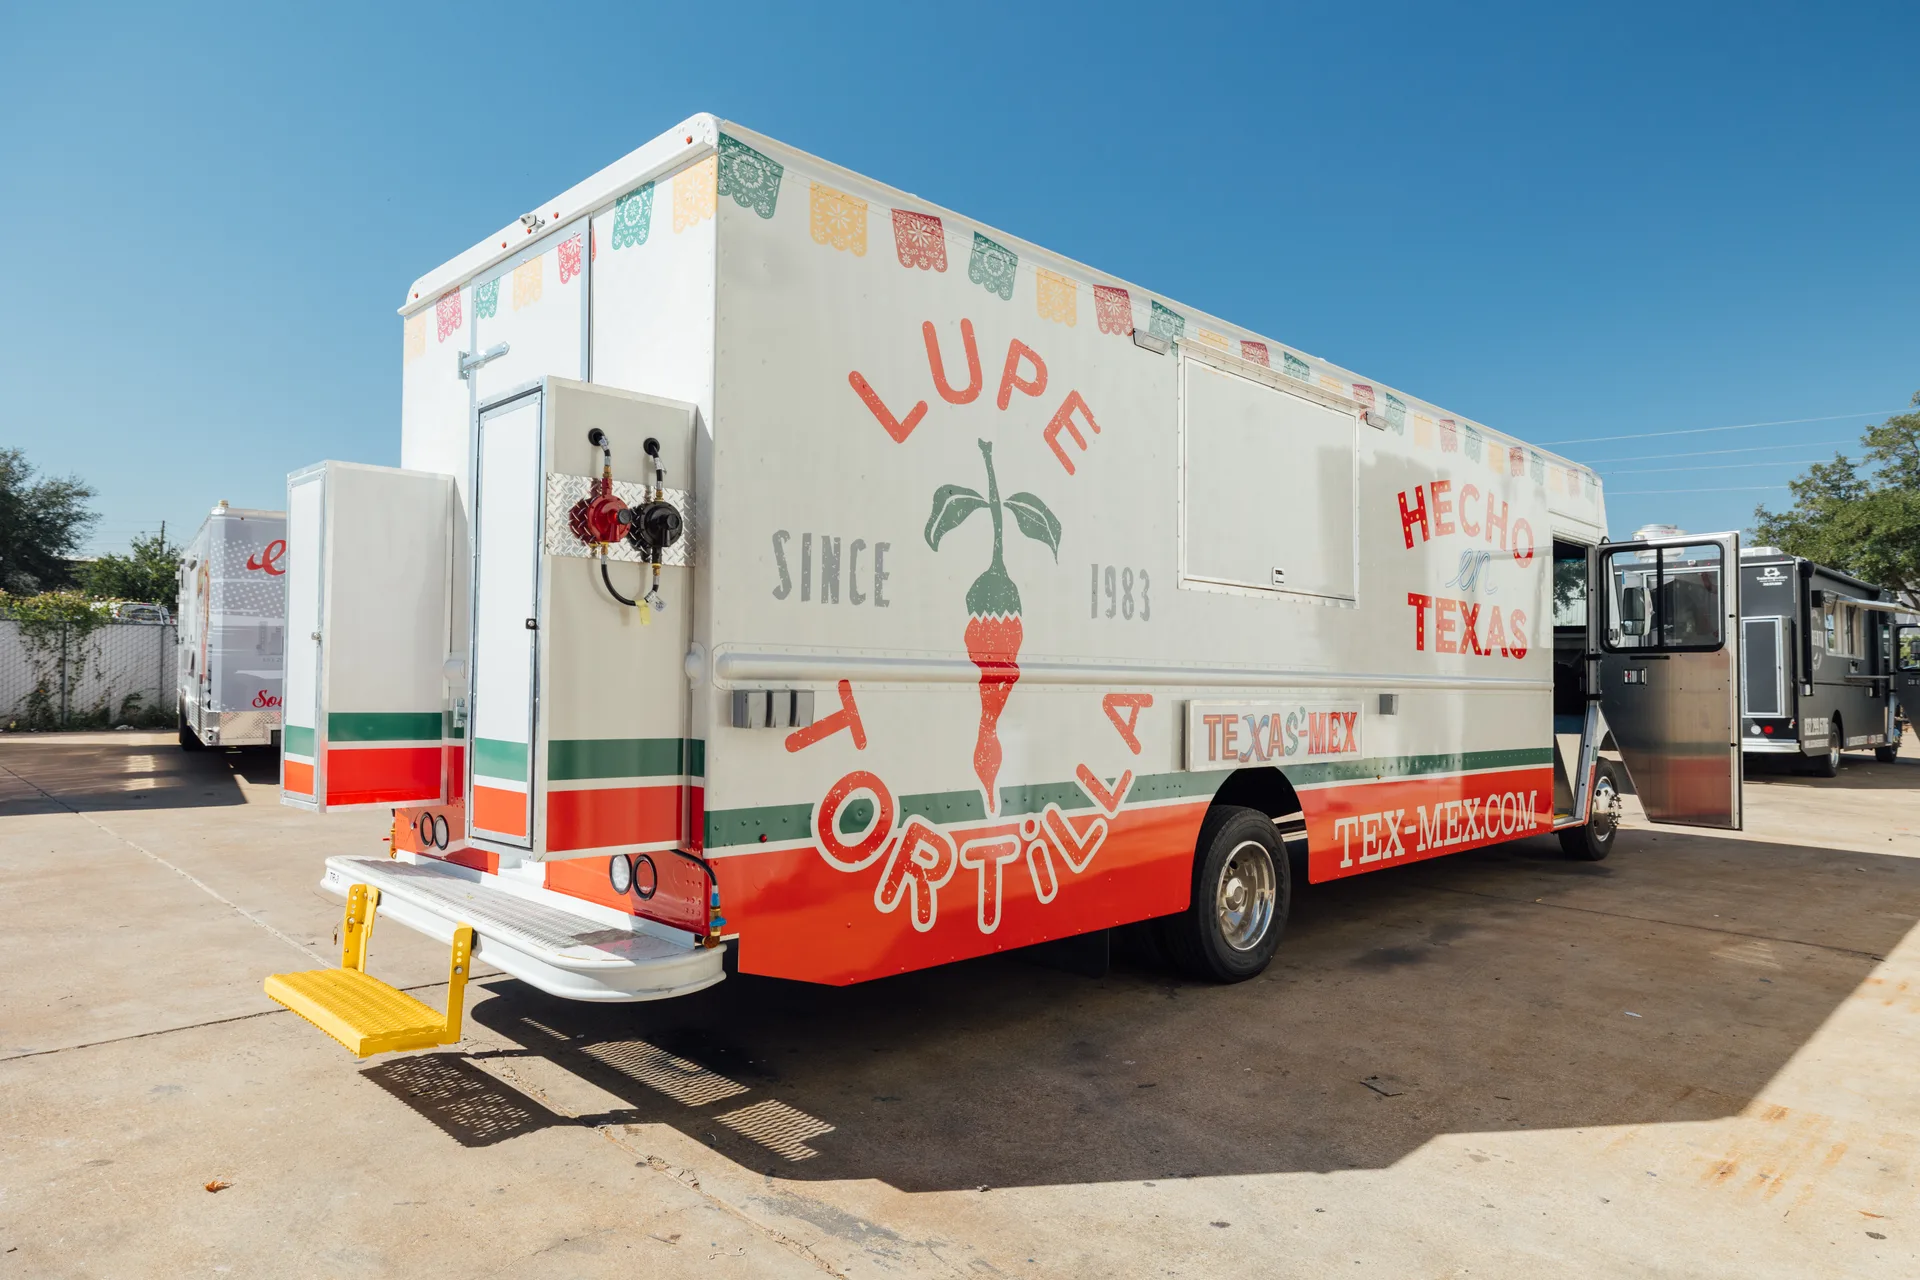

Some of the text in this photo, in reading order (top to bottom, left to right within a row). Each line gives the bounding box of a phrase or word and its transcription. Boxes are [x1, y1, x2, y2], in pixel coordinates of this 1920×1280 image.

[848, 318, 1102, 476] LUPE
[1397, 479, 1534, 569] HECHO
[772, 529, 891, 608] SINCE
[1090, 563, 1152, 622] 1983
[1445, 548, 1498, 593] en
[1407, 592, 1528, 660] TEXAS
[1334, 790, 1538, 869] TEX-MEX.COM
